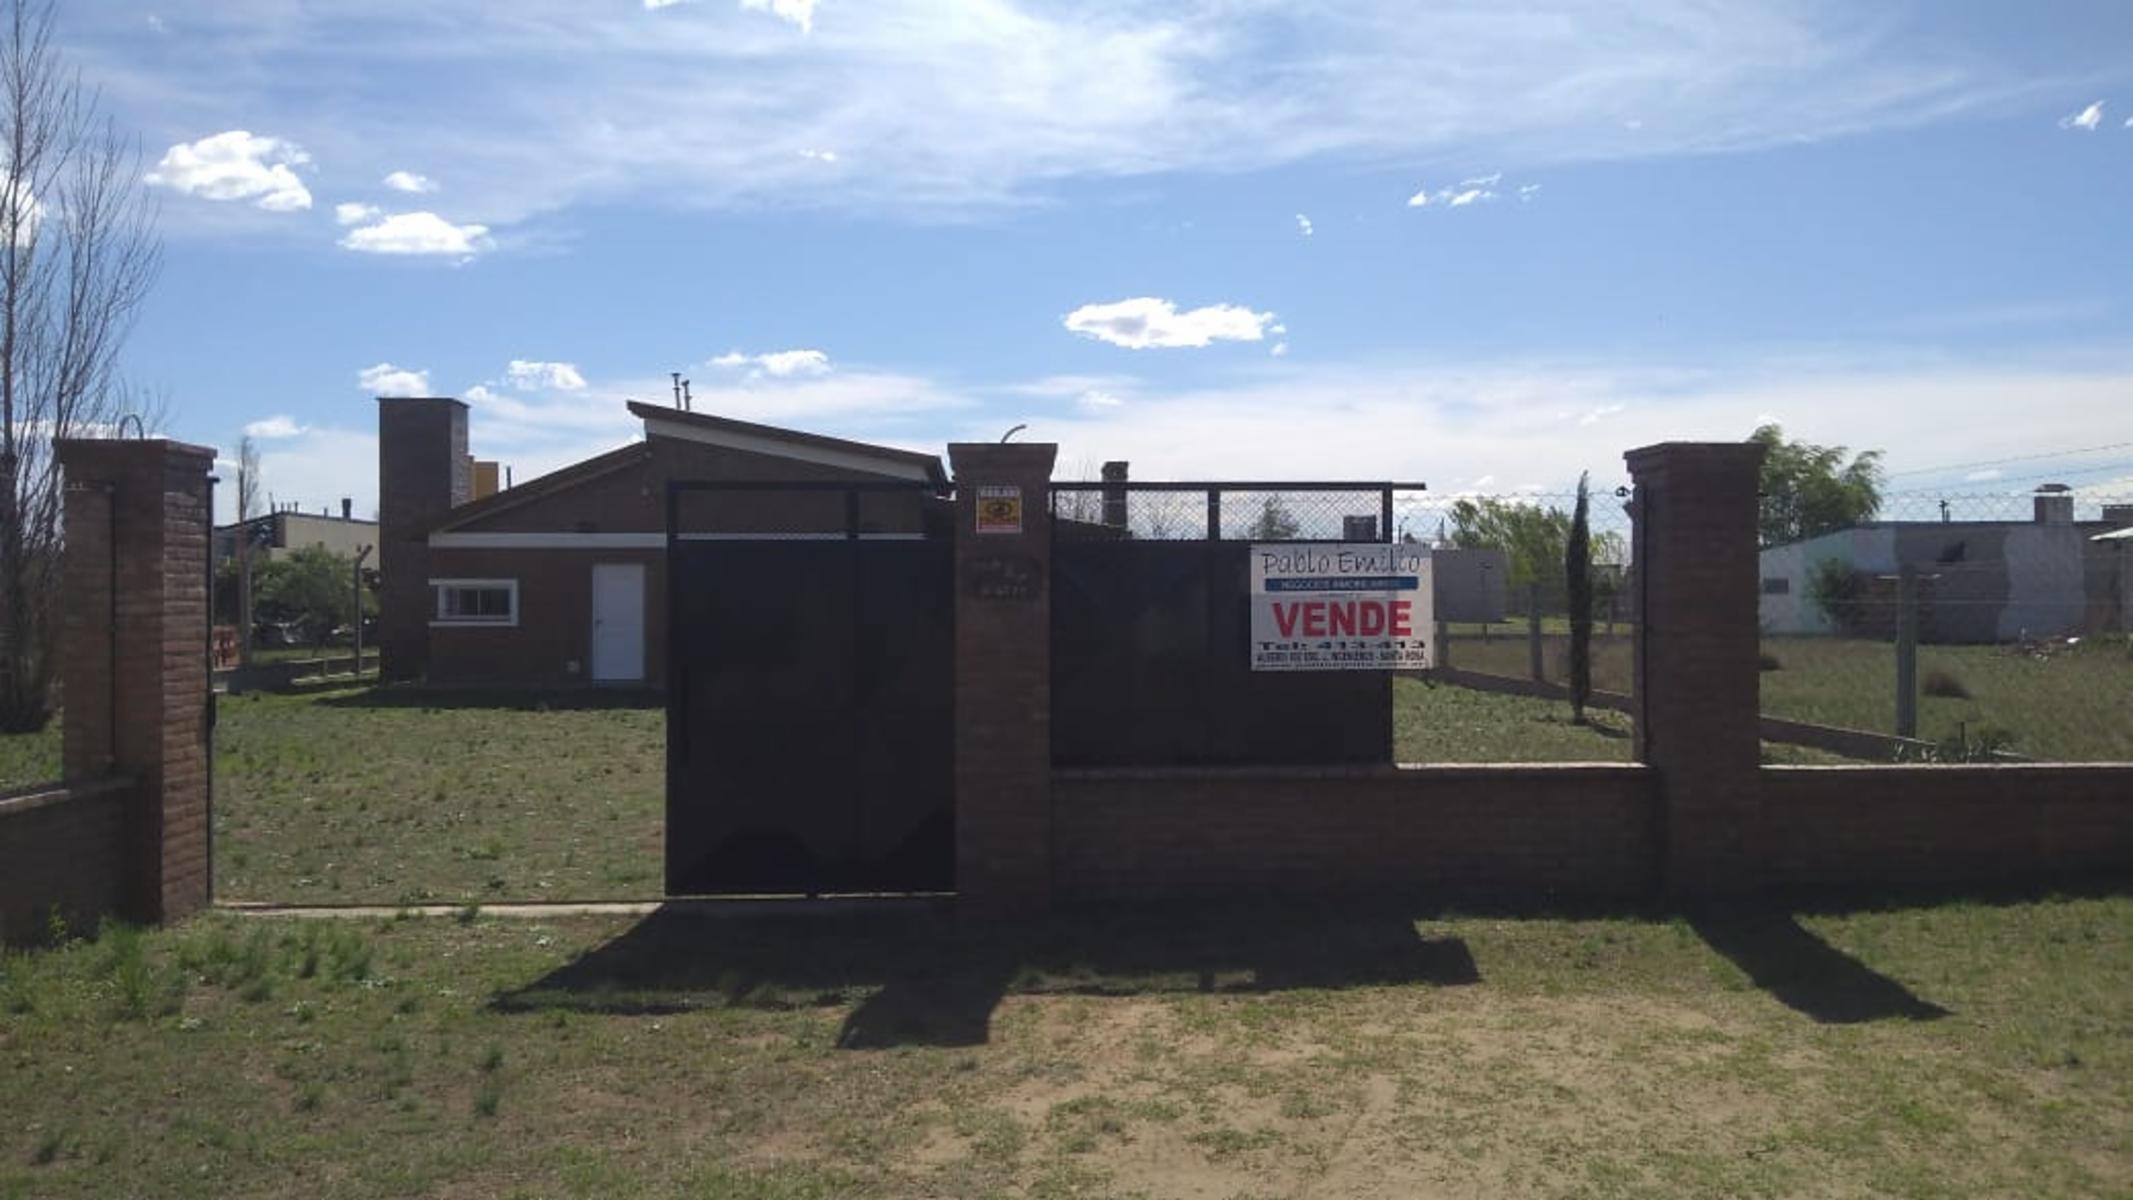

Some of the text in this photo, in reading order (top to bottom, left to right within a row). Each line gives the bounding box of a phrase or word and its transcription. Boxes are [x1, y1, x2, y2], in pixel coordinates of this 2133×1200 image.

[1263, 548, 1421, 574] Pablo Emilio
[1272, 600, 1413, 638] VENDE
